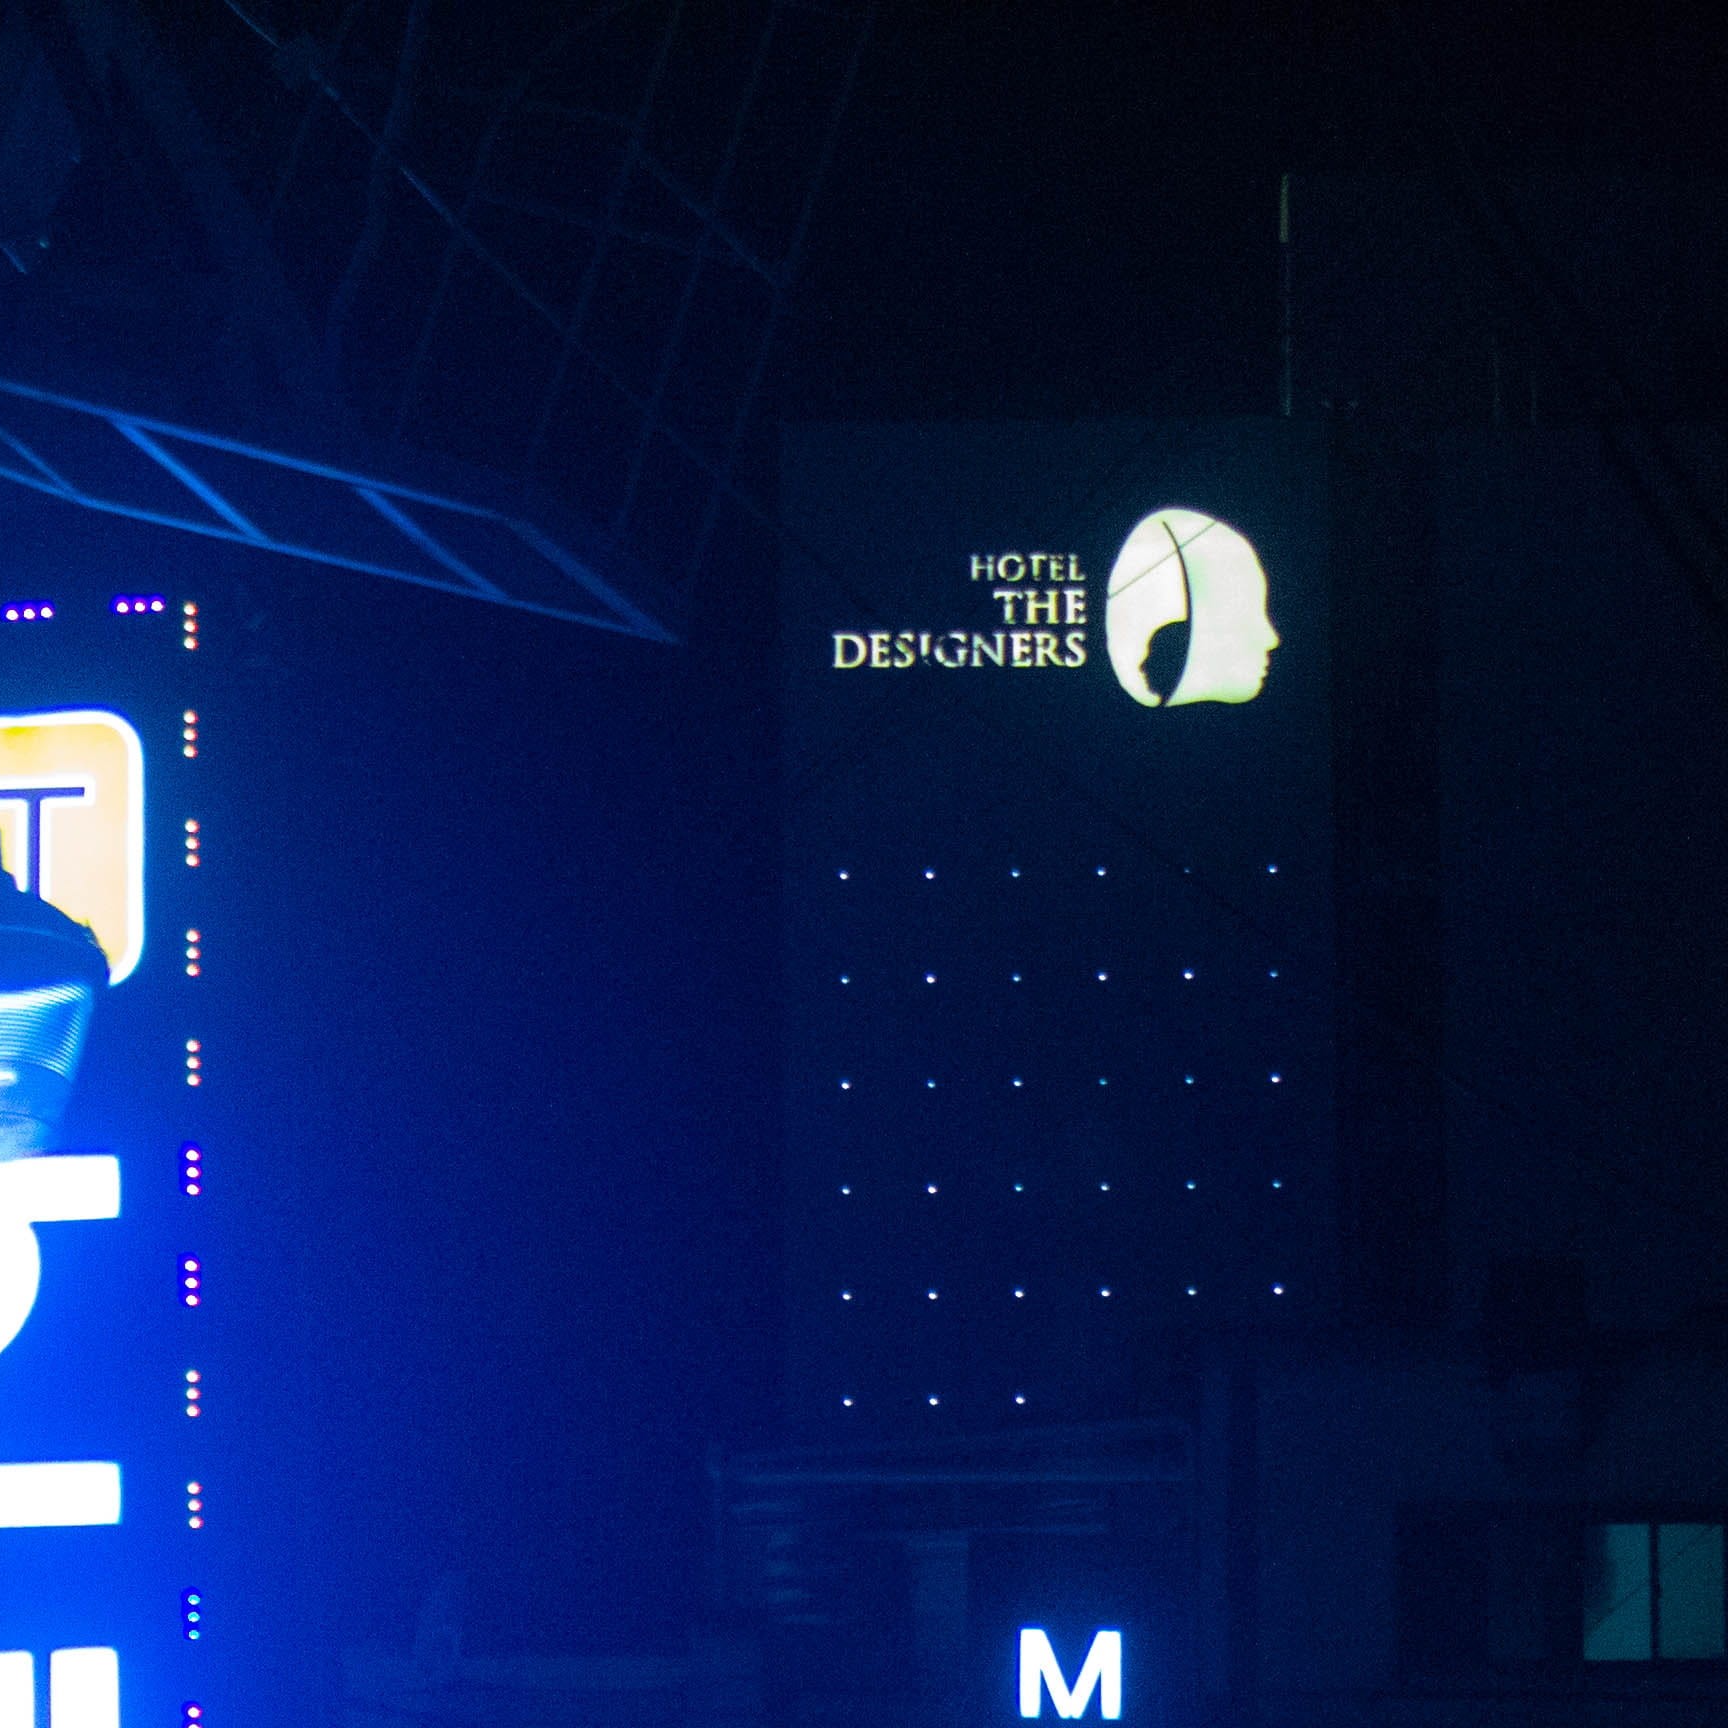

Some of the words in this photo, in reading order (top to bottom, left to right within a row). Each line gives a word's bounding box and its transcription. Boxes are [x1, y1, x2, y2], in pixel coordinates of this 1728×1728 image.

[970, 553, 1085, 582] HOTEL
[993, 589, 1087, 625] THE
[833, 630, 1087, 669] DESIGNERS
